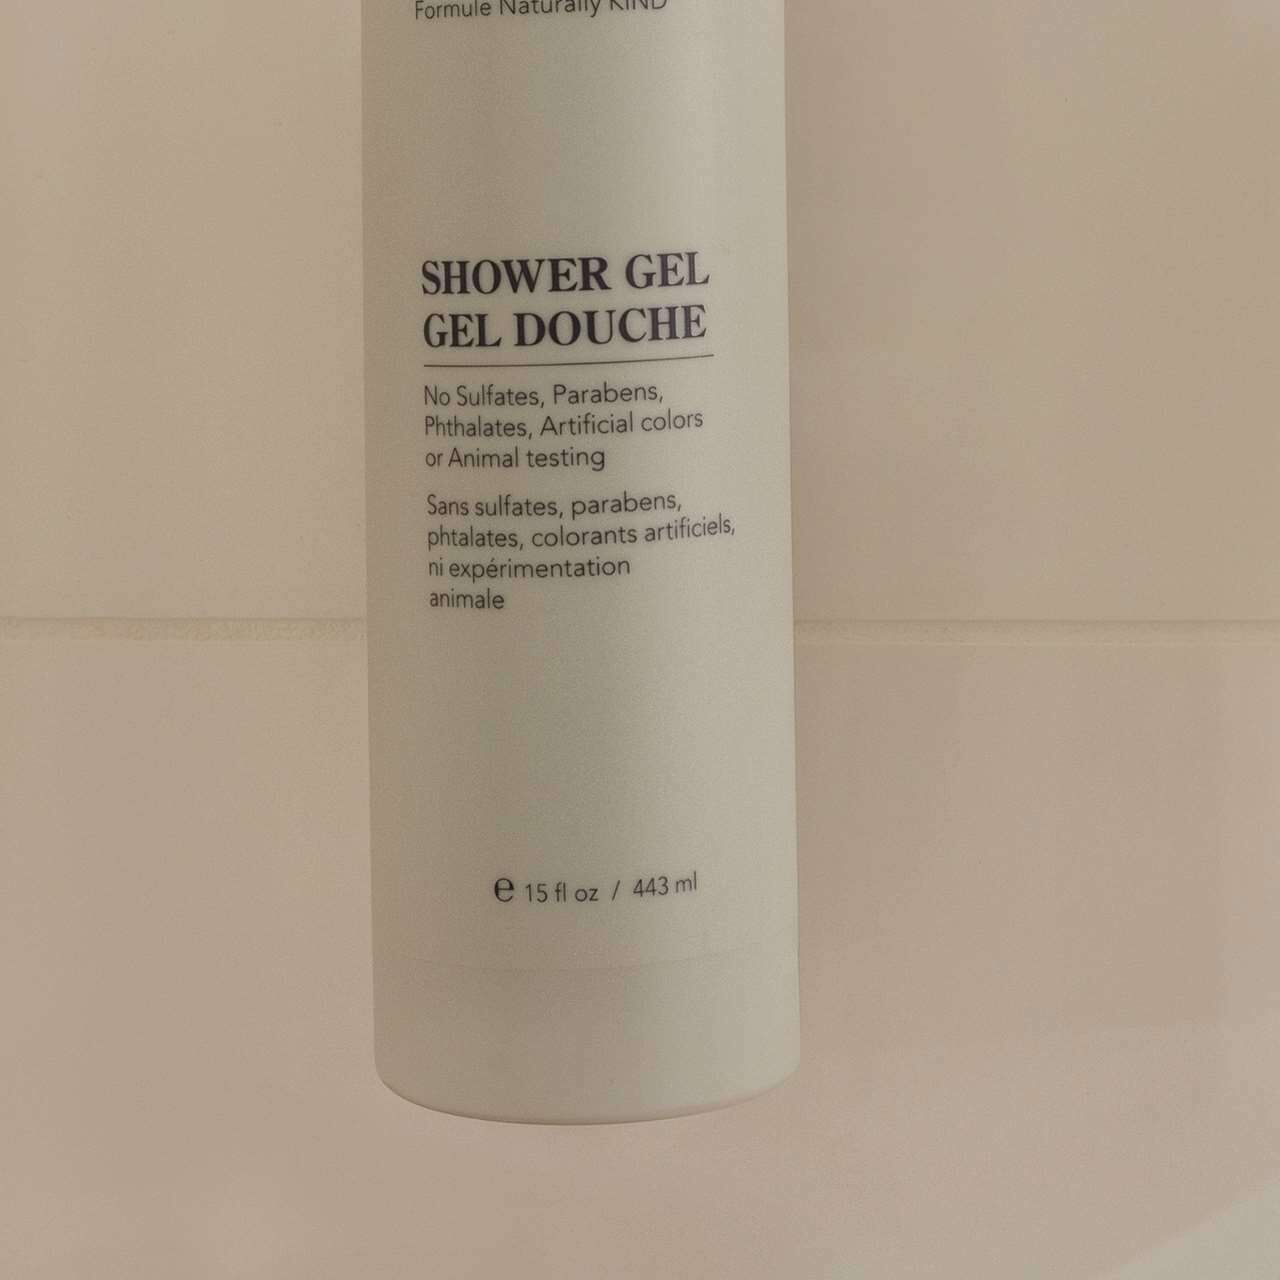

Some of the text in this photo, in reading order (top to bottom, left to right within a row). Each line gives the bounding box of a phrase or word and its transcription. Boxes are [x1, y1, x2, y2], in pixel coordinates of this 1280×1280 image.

[421, 251, 710, 296] SHOWER GEL
[423, 304, 707, 349] GEL DOUCHE
[424, 381, 663, 408] No Sulfates, Parabens,
[425, 408, 703, 440] Phthalates, Artificial colors
[425, 445, 605, 472] or Animal testing
[427, 490, 684, 522] Sans sulfates, parabens,
[428, 512, 735, 552] phtalates, colorants artificiels,
[429, 556, 630, 584] ni expérimentation
[429, 587, 505, 610] animale
[525, 883, 548, 903] 15
[553, 880, 566, 904] fl
[574, 888, 599, 903] oz
[612, 880, 620, 901] /
[632, 875, 670, 898] 443
[674, 870, 698, 893] ml
